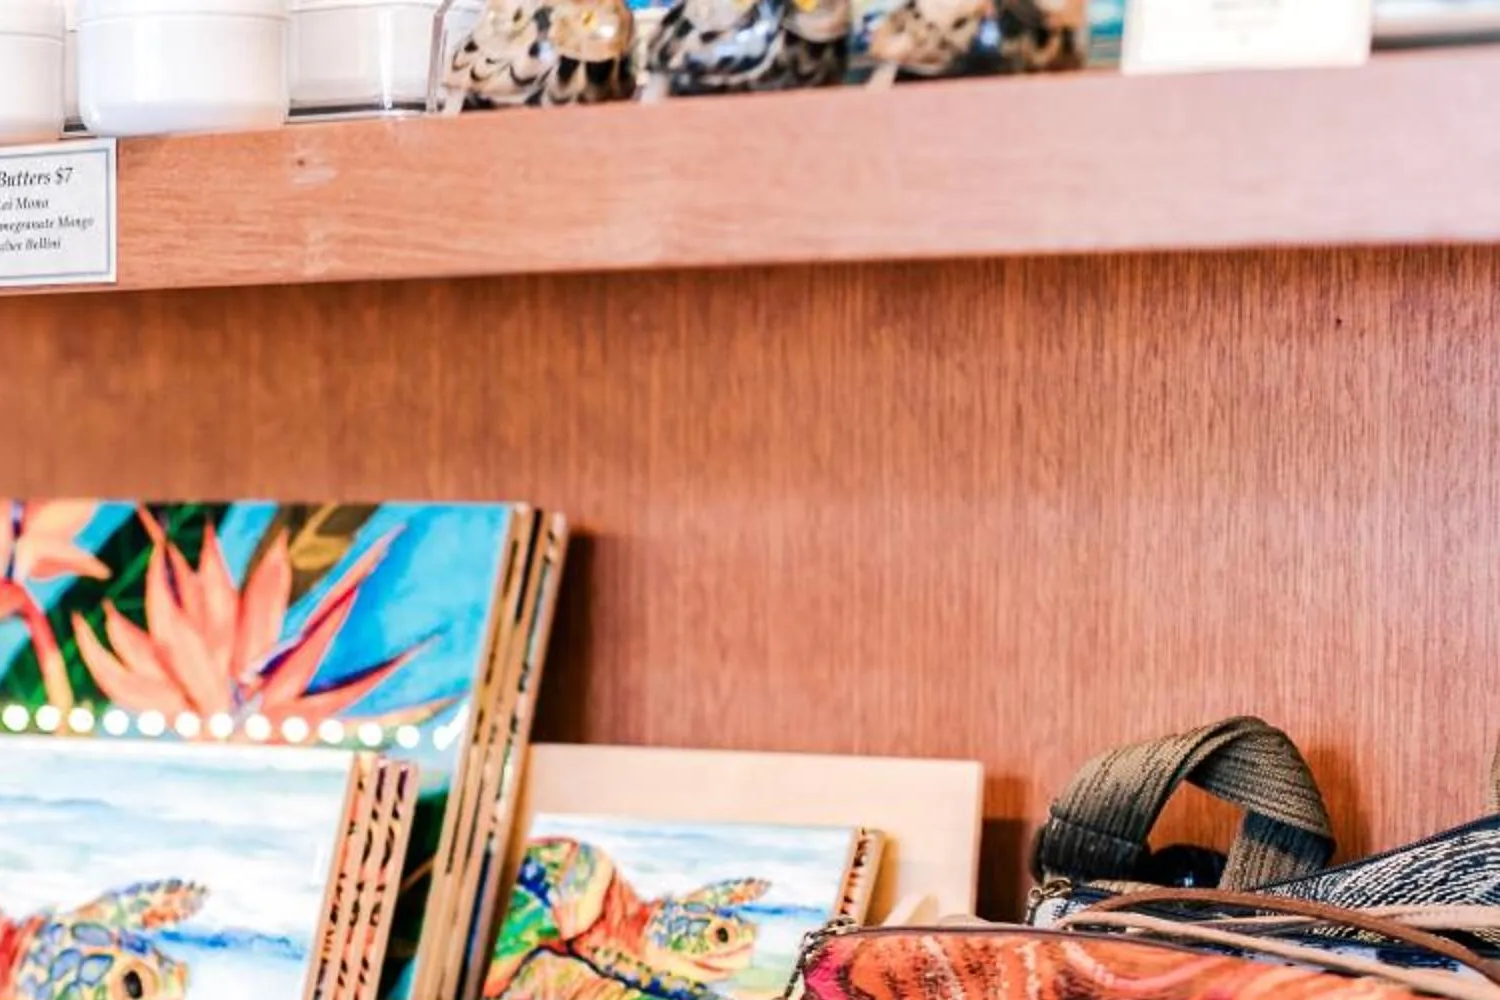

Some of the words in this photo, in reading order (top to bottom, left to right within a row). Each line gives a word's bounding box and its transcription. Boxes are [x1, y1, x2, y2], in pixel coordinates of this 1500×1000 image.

[55, 167, 73, 184] $7
[58, 216, 95, 229] Mango
[25, 236, 61, 250] Bellini
